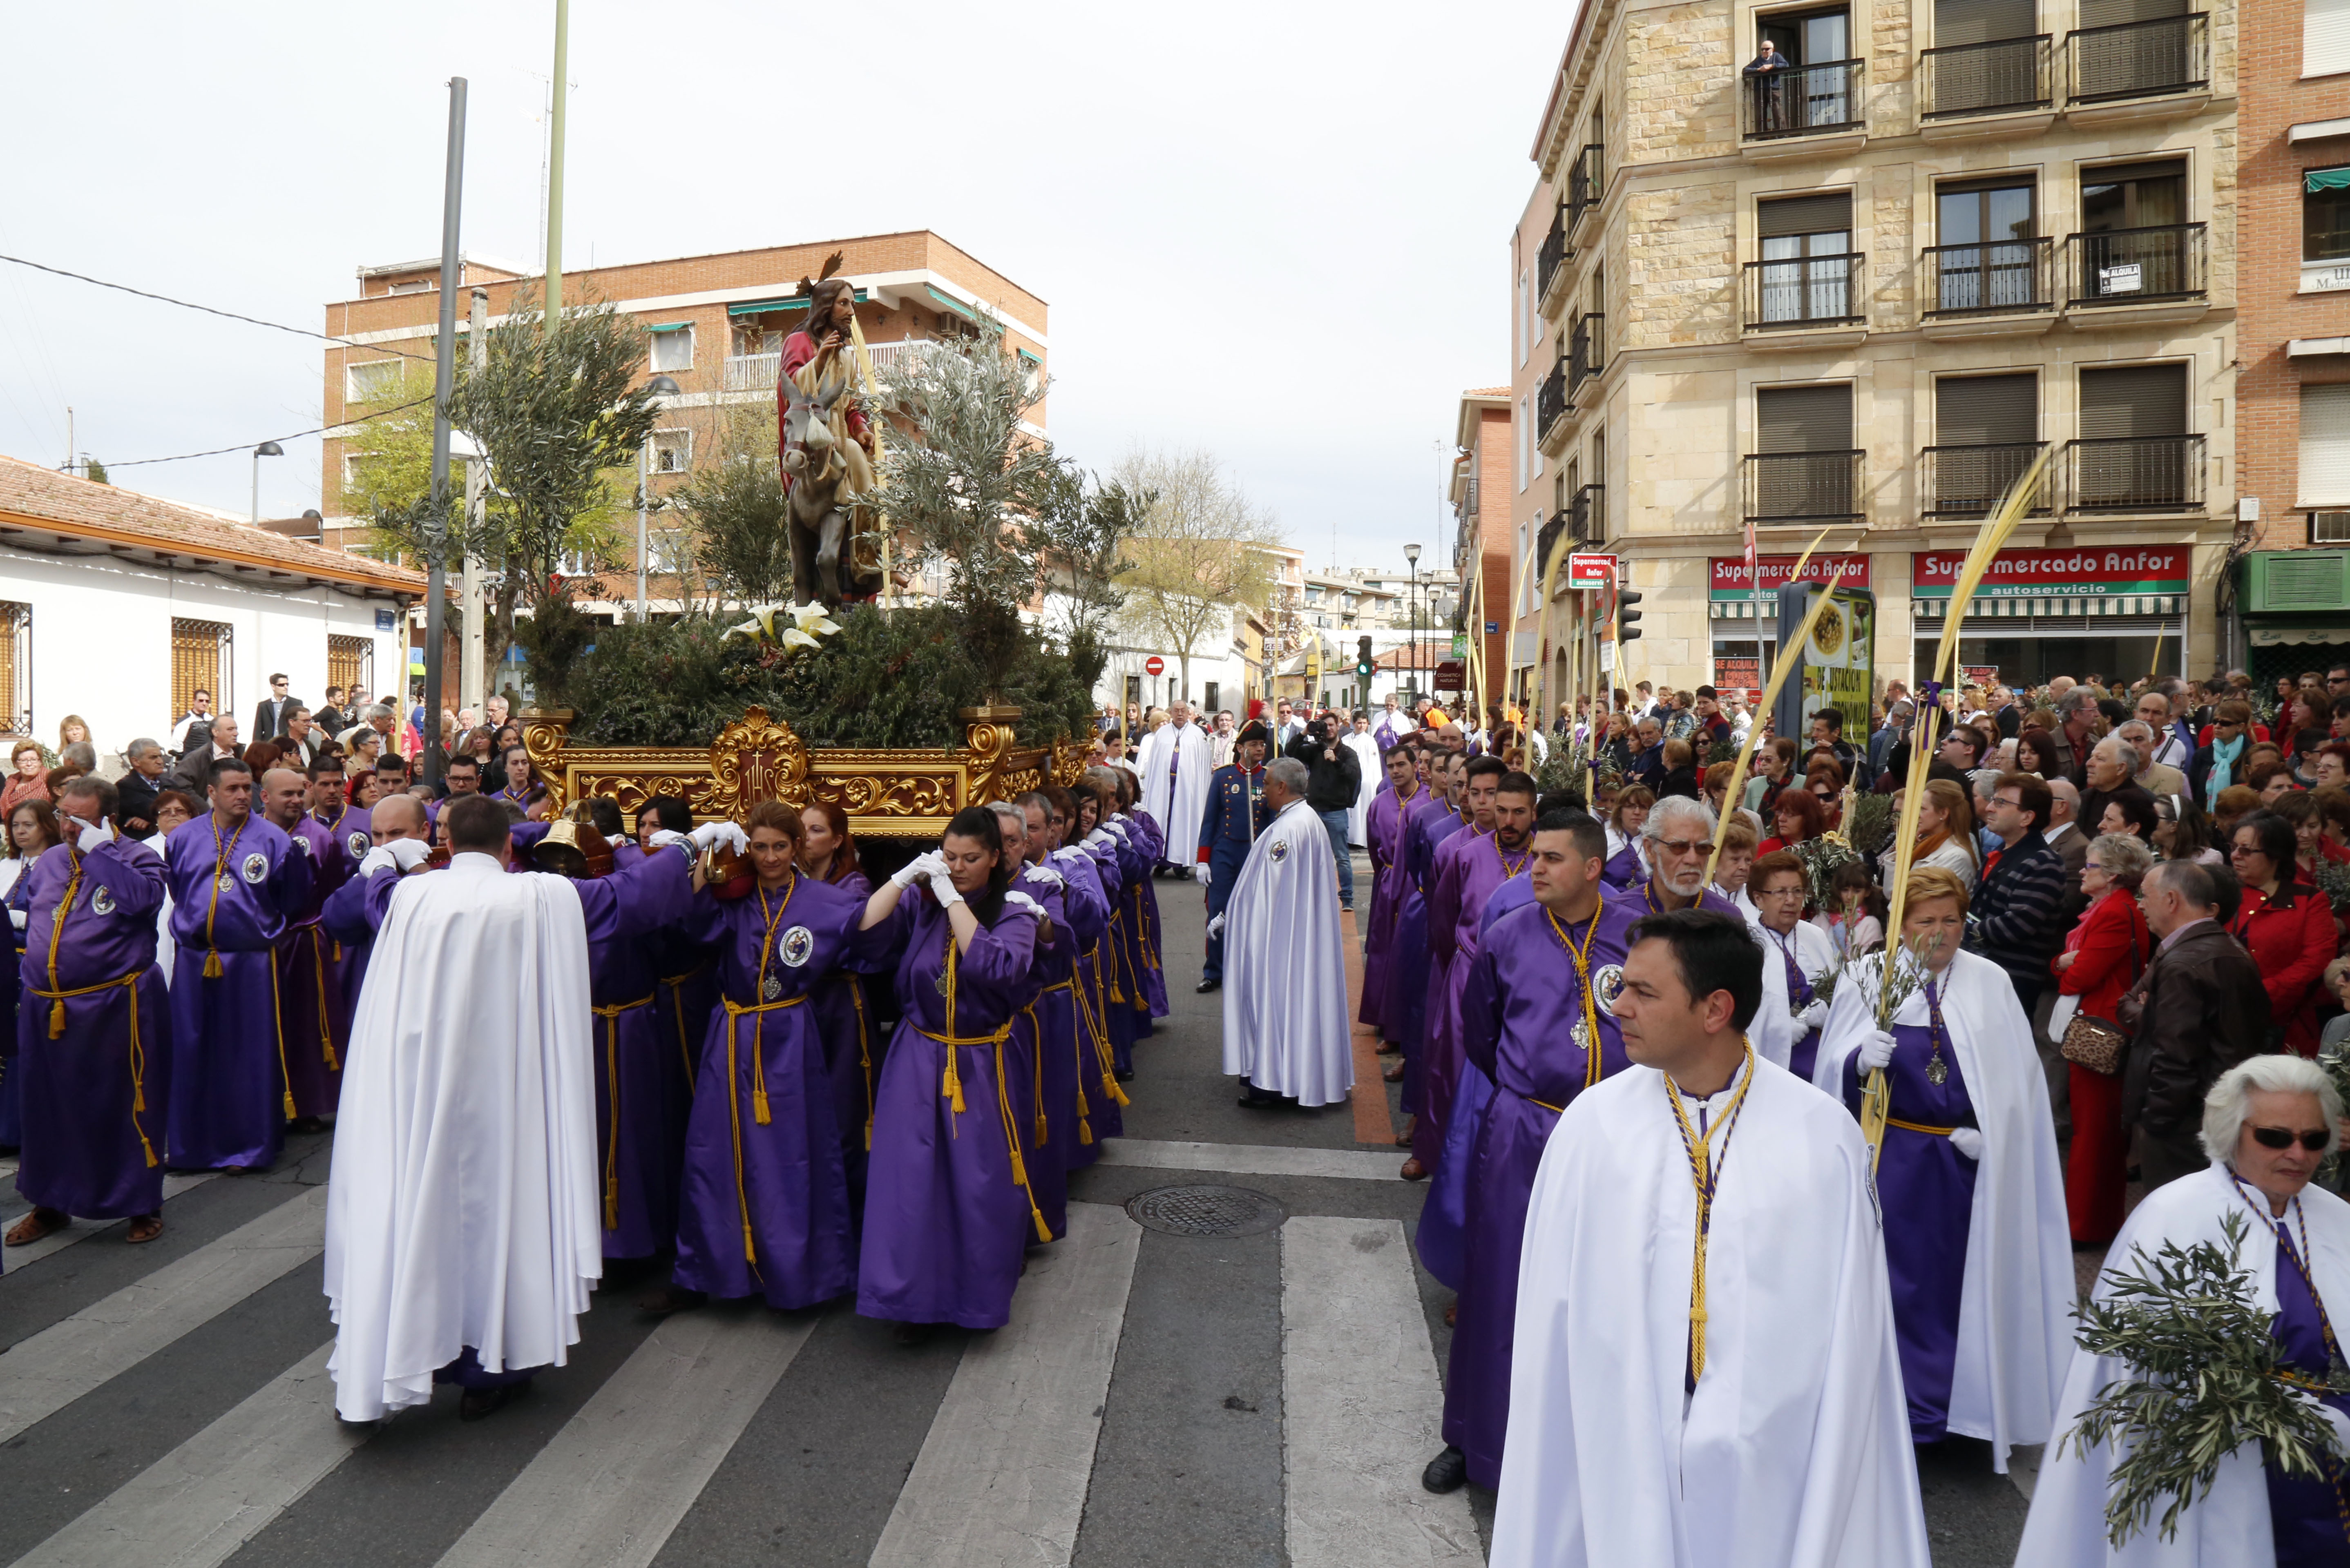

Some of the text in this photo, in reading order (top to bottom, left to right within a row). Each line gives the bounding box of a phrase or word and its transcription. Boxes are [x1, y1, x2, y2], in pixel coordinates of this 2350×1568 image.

[2111, 267, 2138, 277] ALQUILA
[1716, 560, 1819, 582] Supemercado
[1926, 552, 2174, 580] Suprmercado Anfor
[1586, 568, 1603, 576] Anfor
[1992, 584, 2105, 595] autoservicio
[1716, 660, 1758, 669] SE ALQUILA
